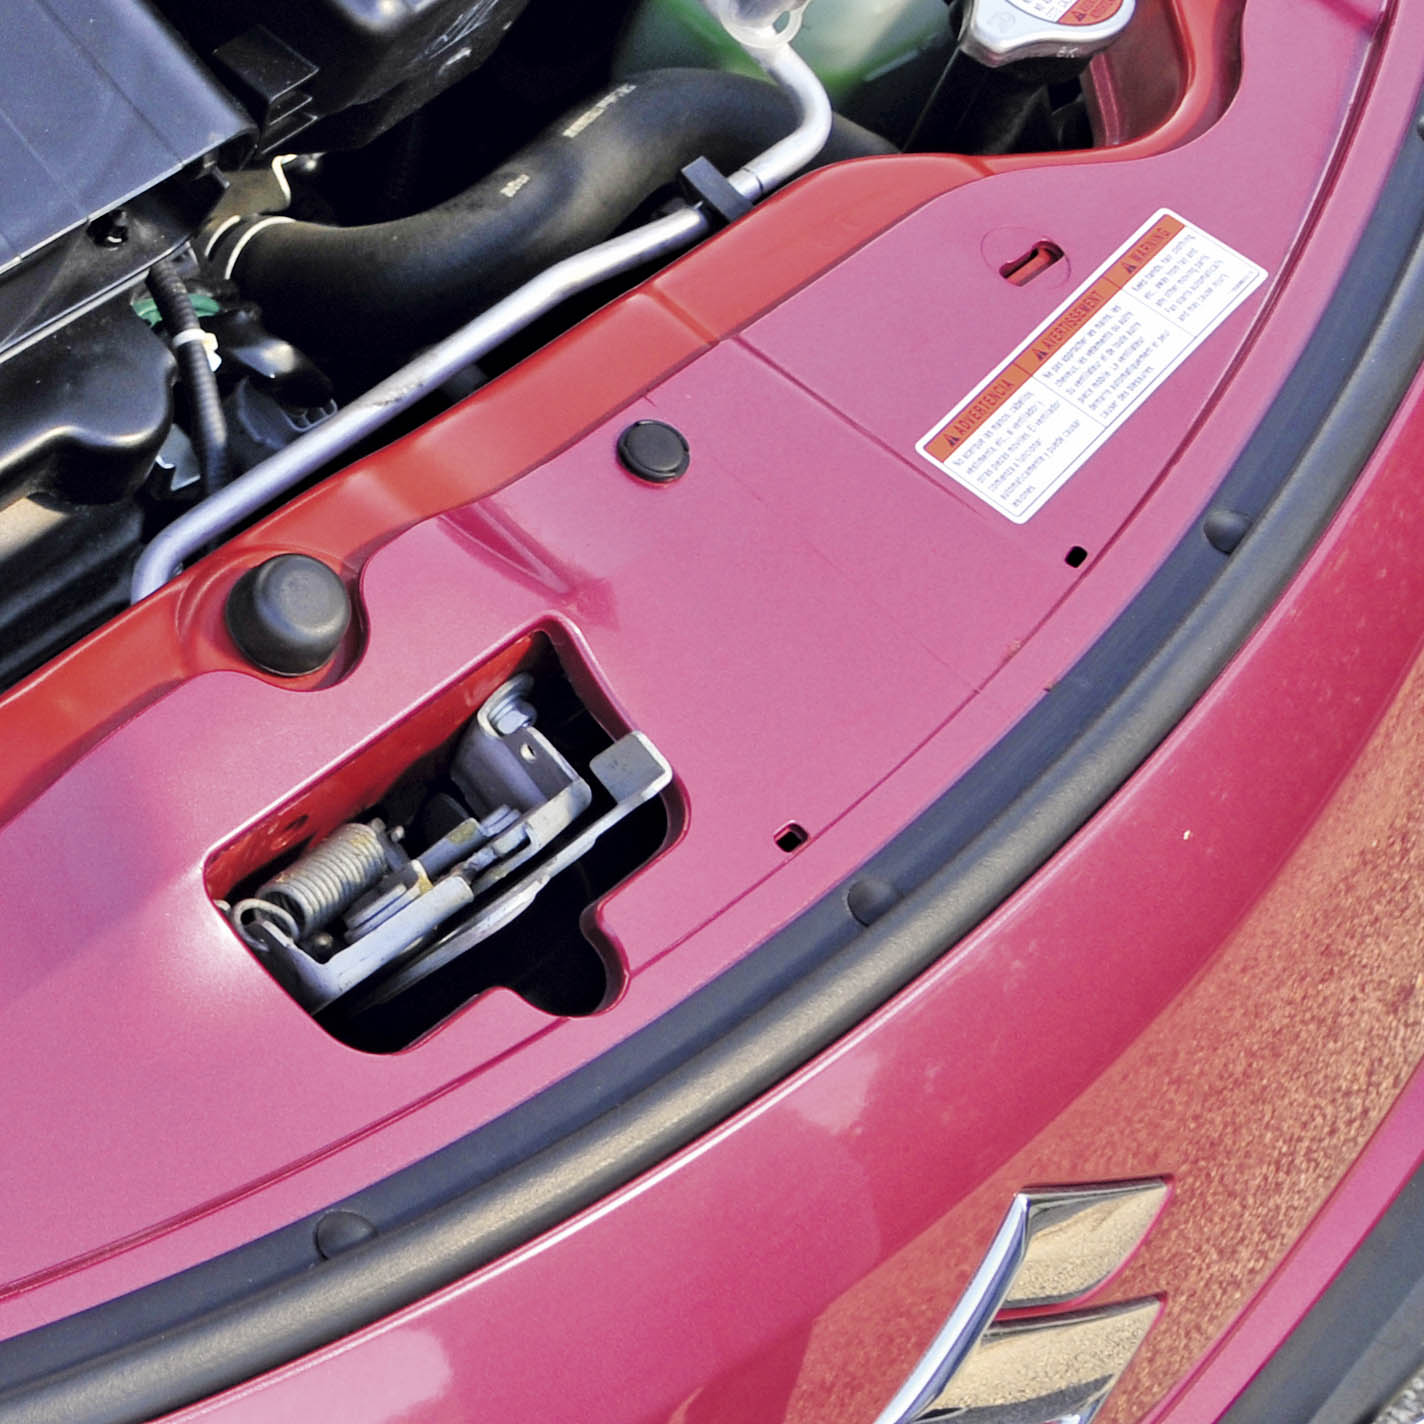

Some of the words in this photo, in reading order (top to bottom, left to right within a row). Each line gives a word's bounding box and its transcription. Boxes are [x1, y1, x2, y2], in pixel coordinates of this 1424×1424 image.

[1128, 225, 1171, 264] WARNING
[1039, 289, 1105, 350] AVERTISSEMENT
[951, 377, 1014, 435] ADVERTENCIA
